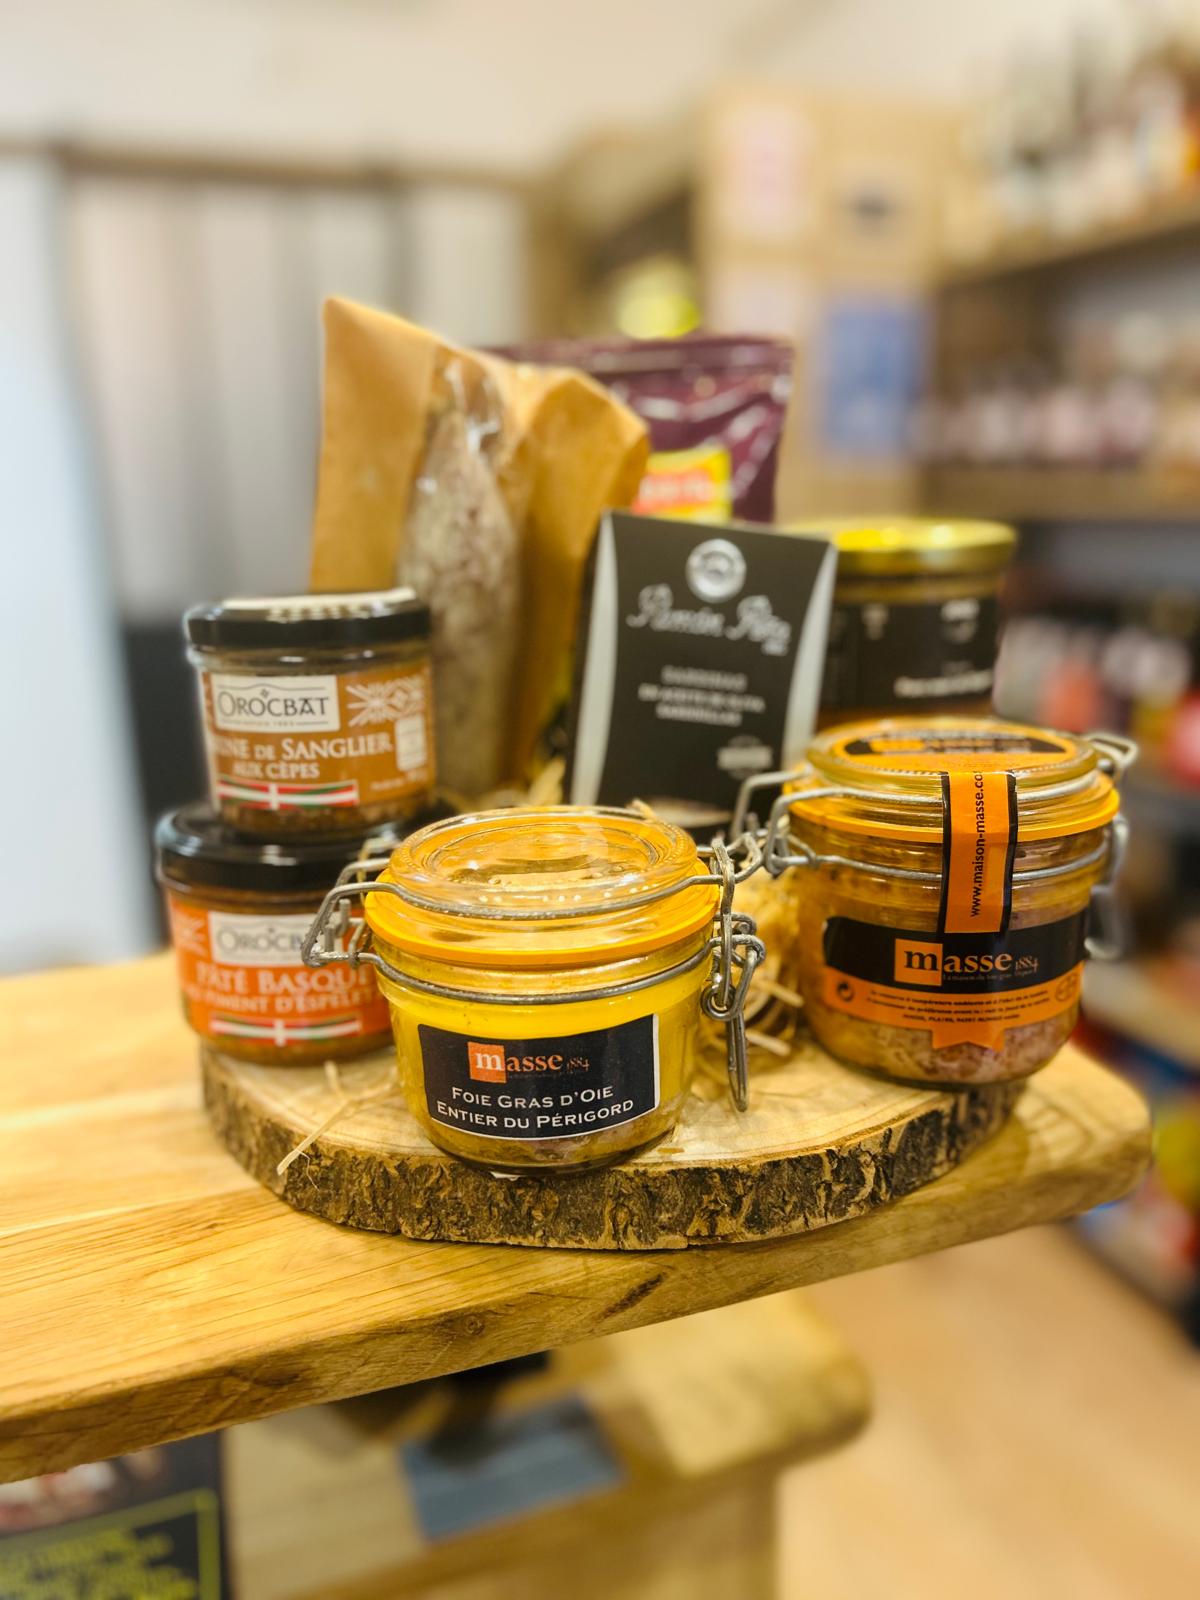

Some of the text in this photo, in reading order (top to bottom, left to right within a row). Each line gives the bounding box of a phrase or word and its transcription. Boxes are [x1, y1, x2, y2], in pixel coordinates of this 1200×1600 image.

[217, 691, 329, 717] OROCBAT
[282, 731, 393, 761] SANGLIER
[904, 951, 1013, 973] masse
[475, 1053, 563, 1072] masse
[452, 1086, 614, 1109] FOIE GRAS D'OIE
[437, 1099, 634, 1129] ENTIER DU PÉRIGORD
